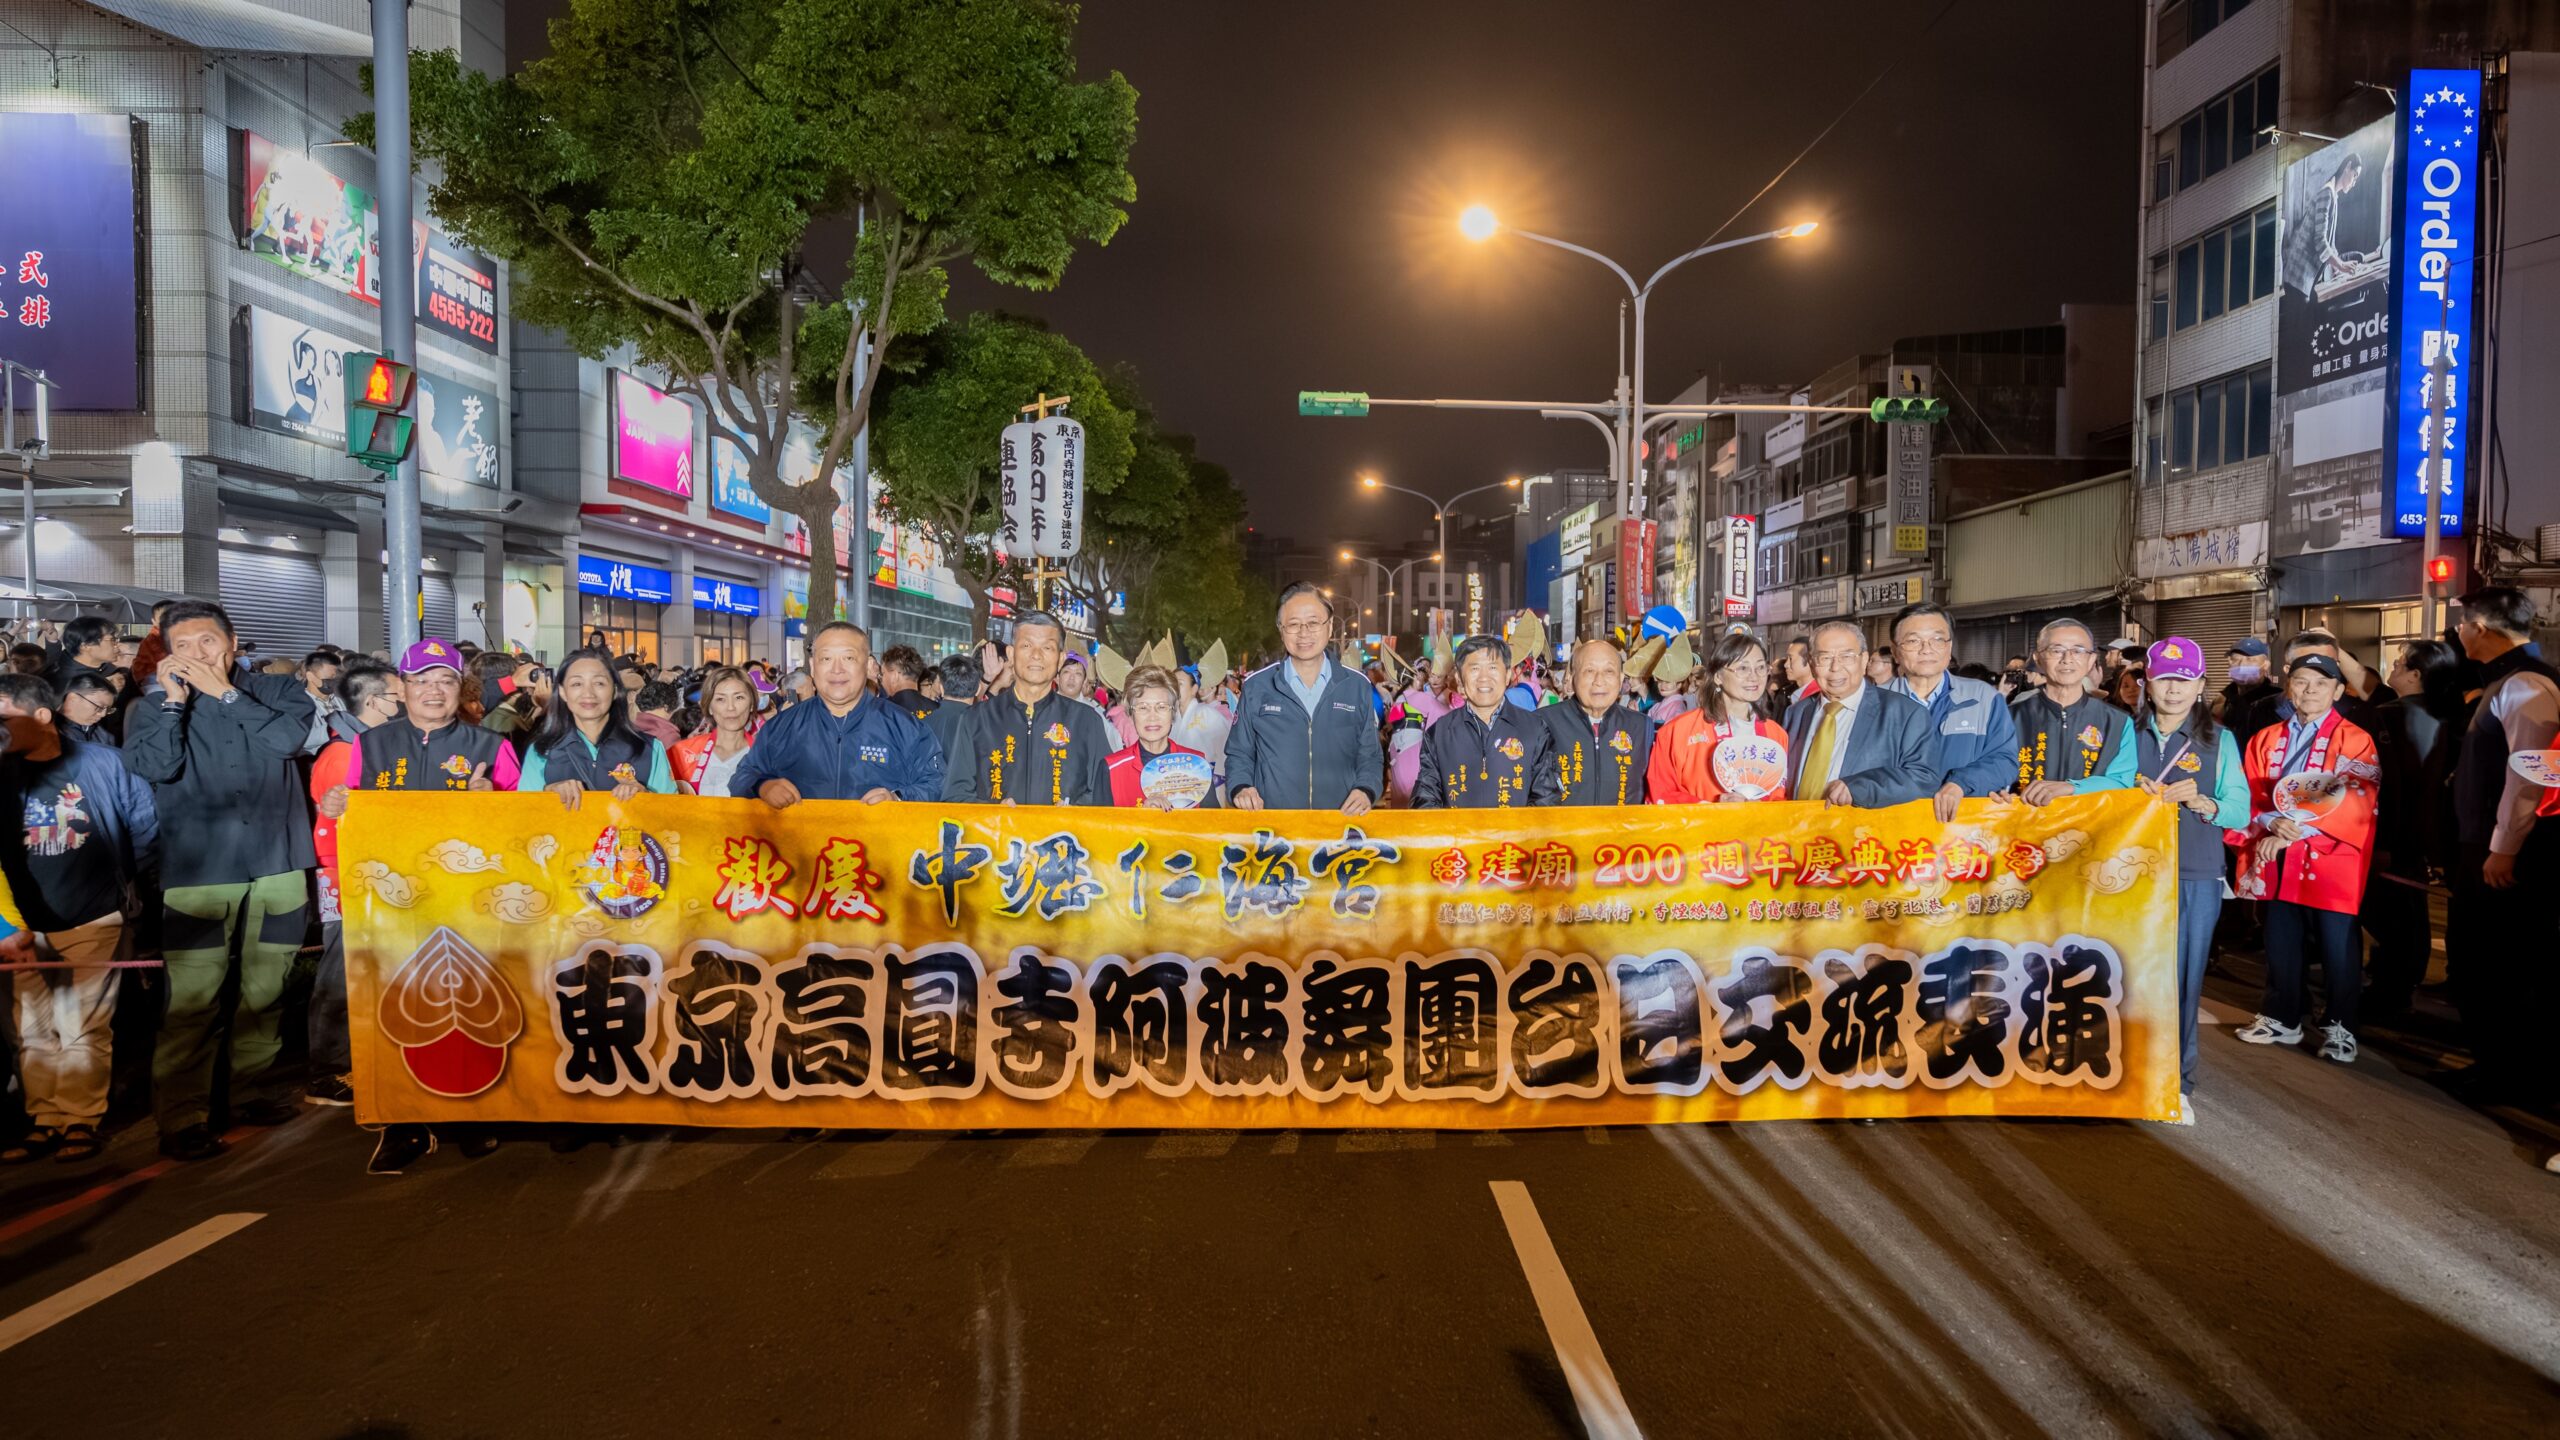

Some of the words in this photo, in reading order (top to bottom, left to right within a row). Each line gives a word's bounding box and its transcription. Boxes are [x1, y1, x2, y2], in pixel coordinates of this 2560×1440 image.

[2420, 158, 2461, 300] Order
[0, 250, 47, 288] 式
[0, 294, 51, 328] 排
[429, 291, 495, 342] 4555-222
[1056, 424, 1081, 438] 東京
[645, 837, 665, 861] Zhongli
[712, 834, 886, 922] 歡慶
[908, 818, 1401, 927] 中壢仁海宮
[1479, 841, 1575, 890] 建廟
[1593, 842, 1682, 888] 200
[1701, 836, 1990, 888] 週年慶典活動
[555, 940, 2116, 1098] 東京高圓寺阿波舞團台日交流表演
